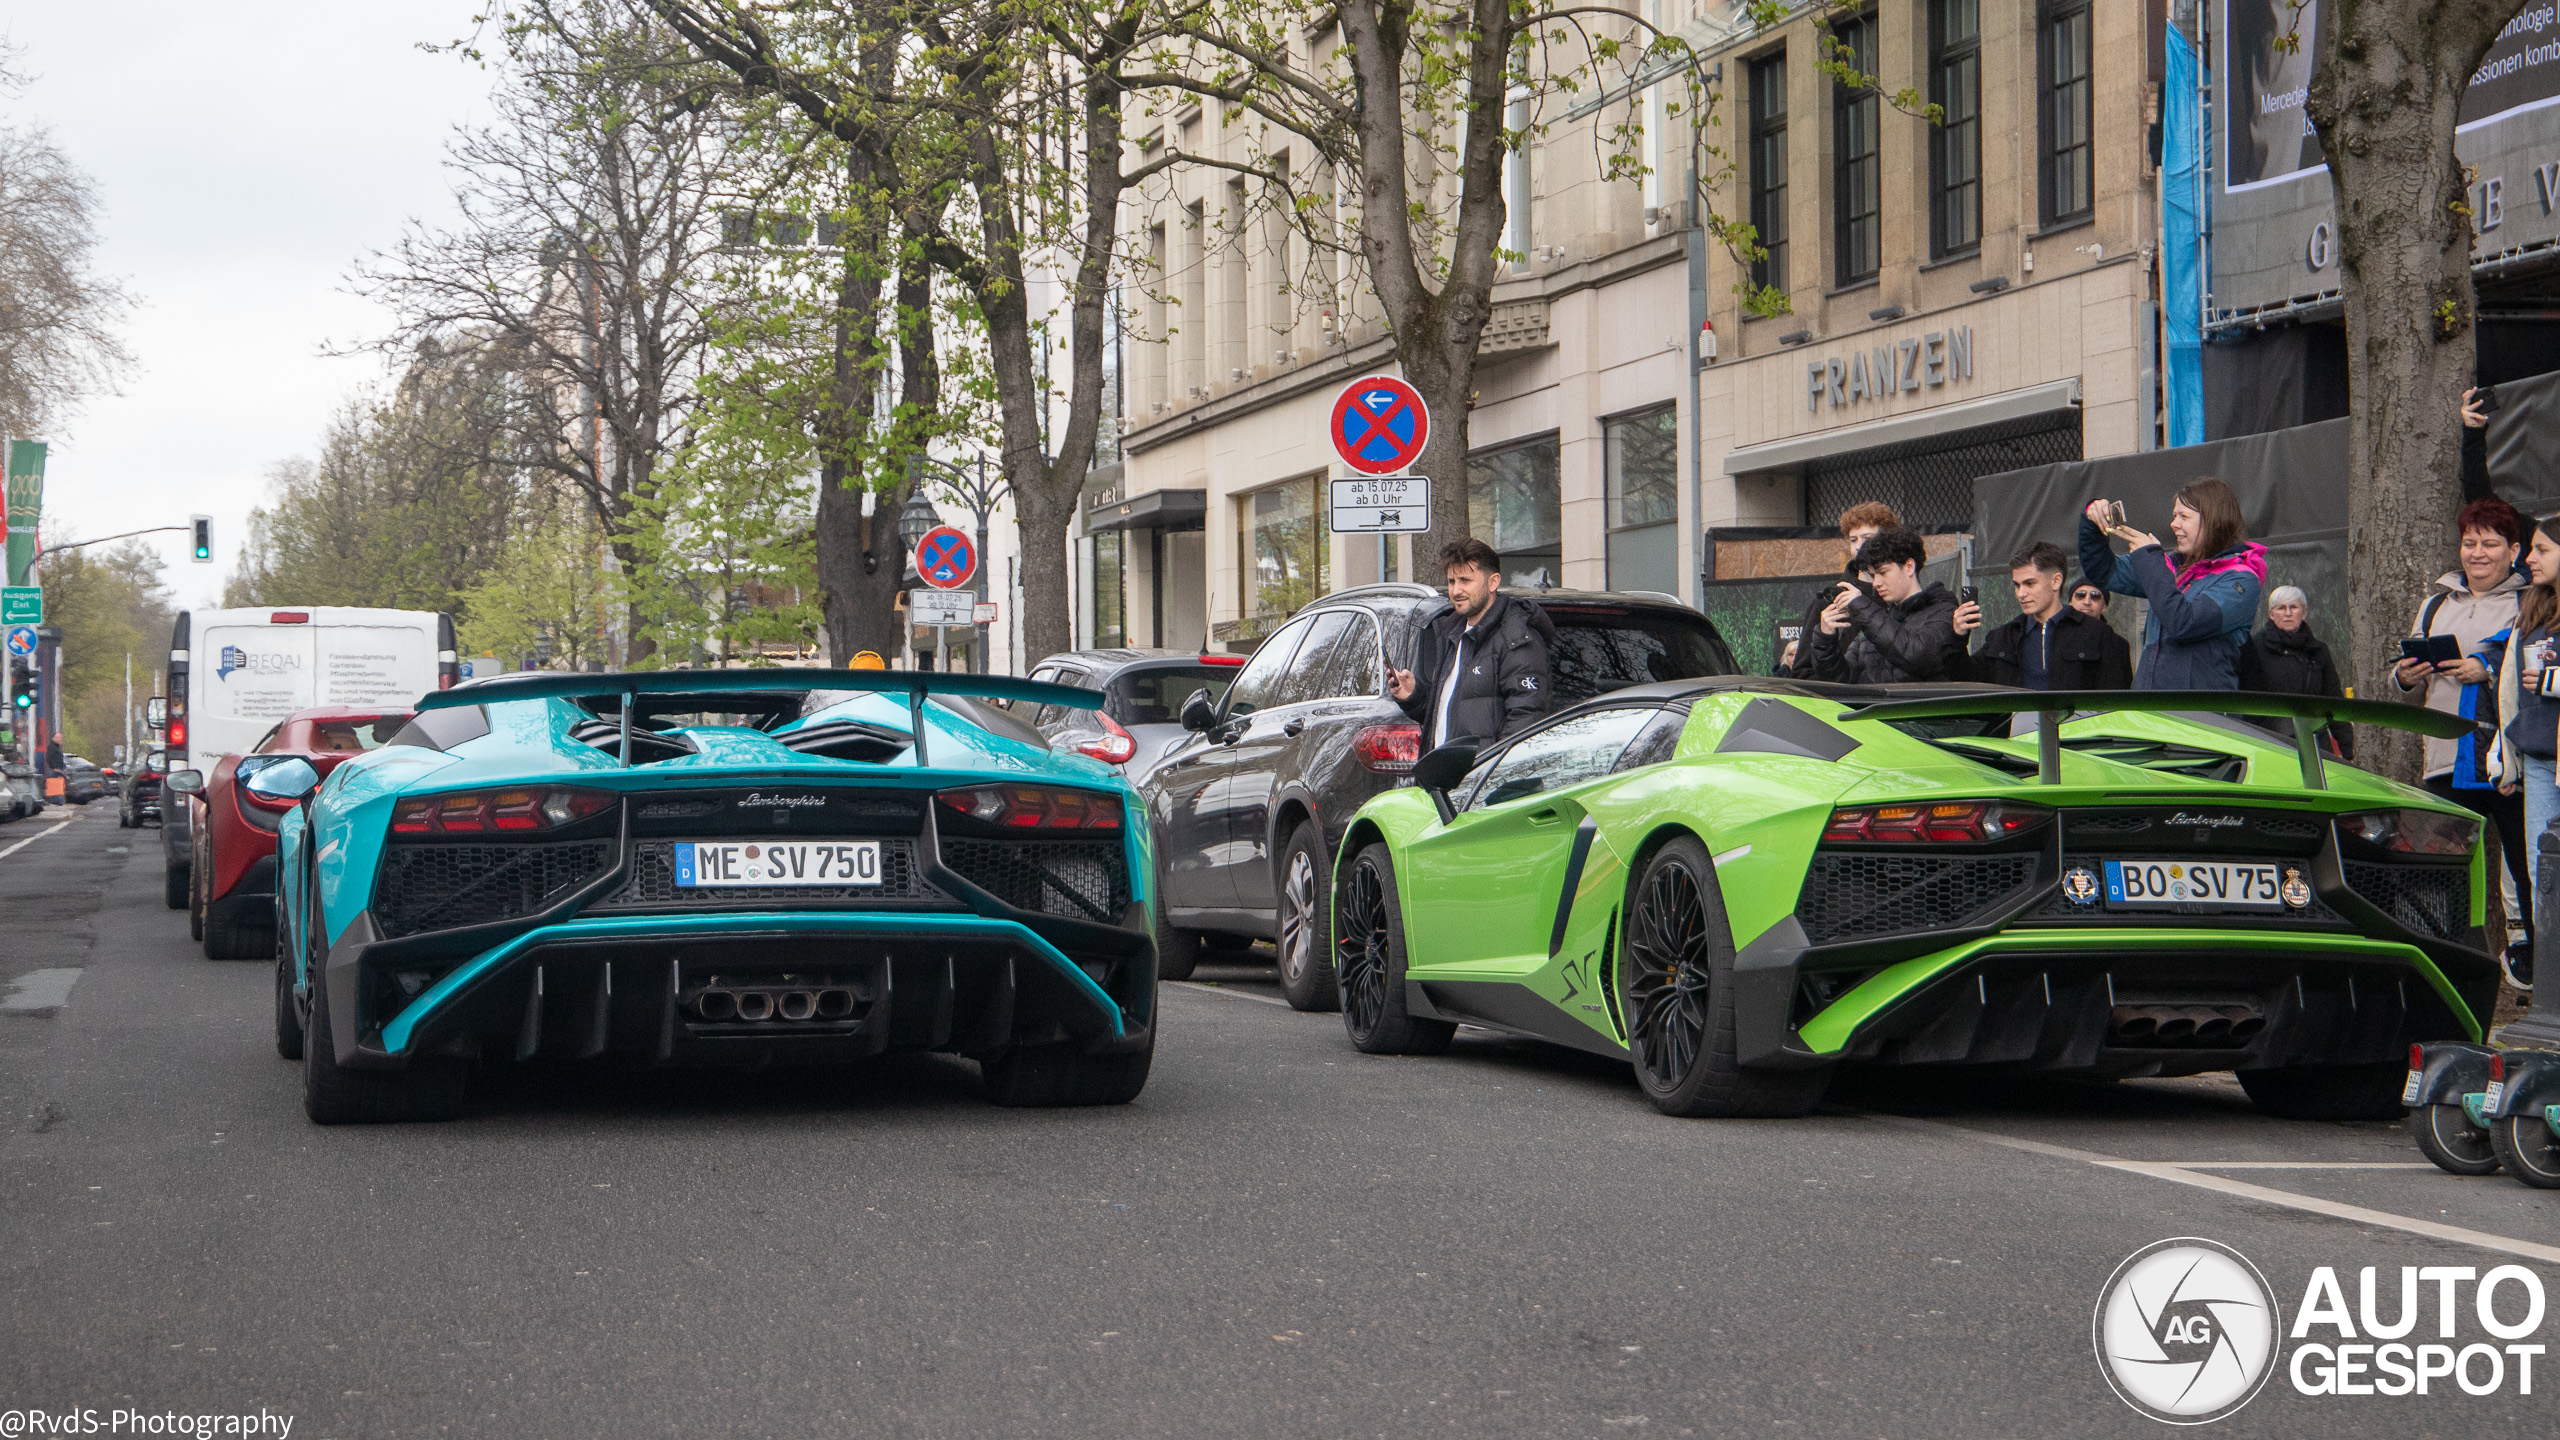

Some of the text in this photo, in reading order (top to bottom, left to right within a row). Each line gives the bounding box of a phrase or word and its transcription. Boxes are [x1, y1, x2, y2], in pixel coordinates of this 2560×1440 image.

[2495, 3, 2554, 41] nologie
[2469, 52, 2522, 87] issionen
[1807, 325, 1972, 412] FRANZEN
[1351, 481, 1408, 493] ab 15.07.25
[1356, 494, 1402, 505] ab 0 Uhr
[3, 592, 40, 600] Ausgang
[12, 600, 30, 609] Exit
[737, 793, 827, 808] Lamborghini
[2164, 812, 2245, 827] Lamborghini
[699, 846, 742, 880] ME
[767, 846, 807, 879] SV
[816, 846, 875, 879] 750
[2122, 865, 2168, 898] BO
[2189, 866, 2229, 899] SV
[2236, 868, 2278, 899] 75
